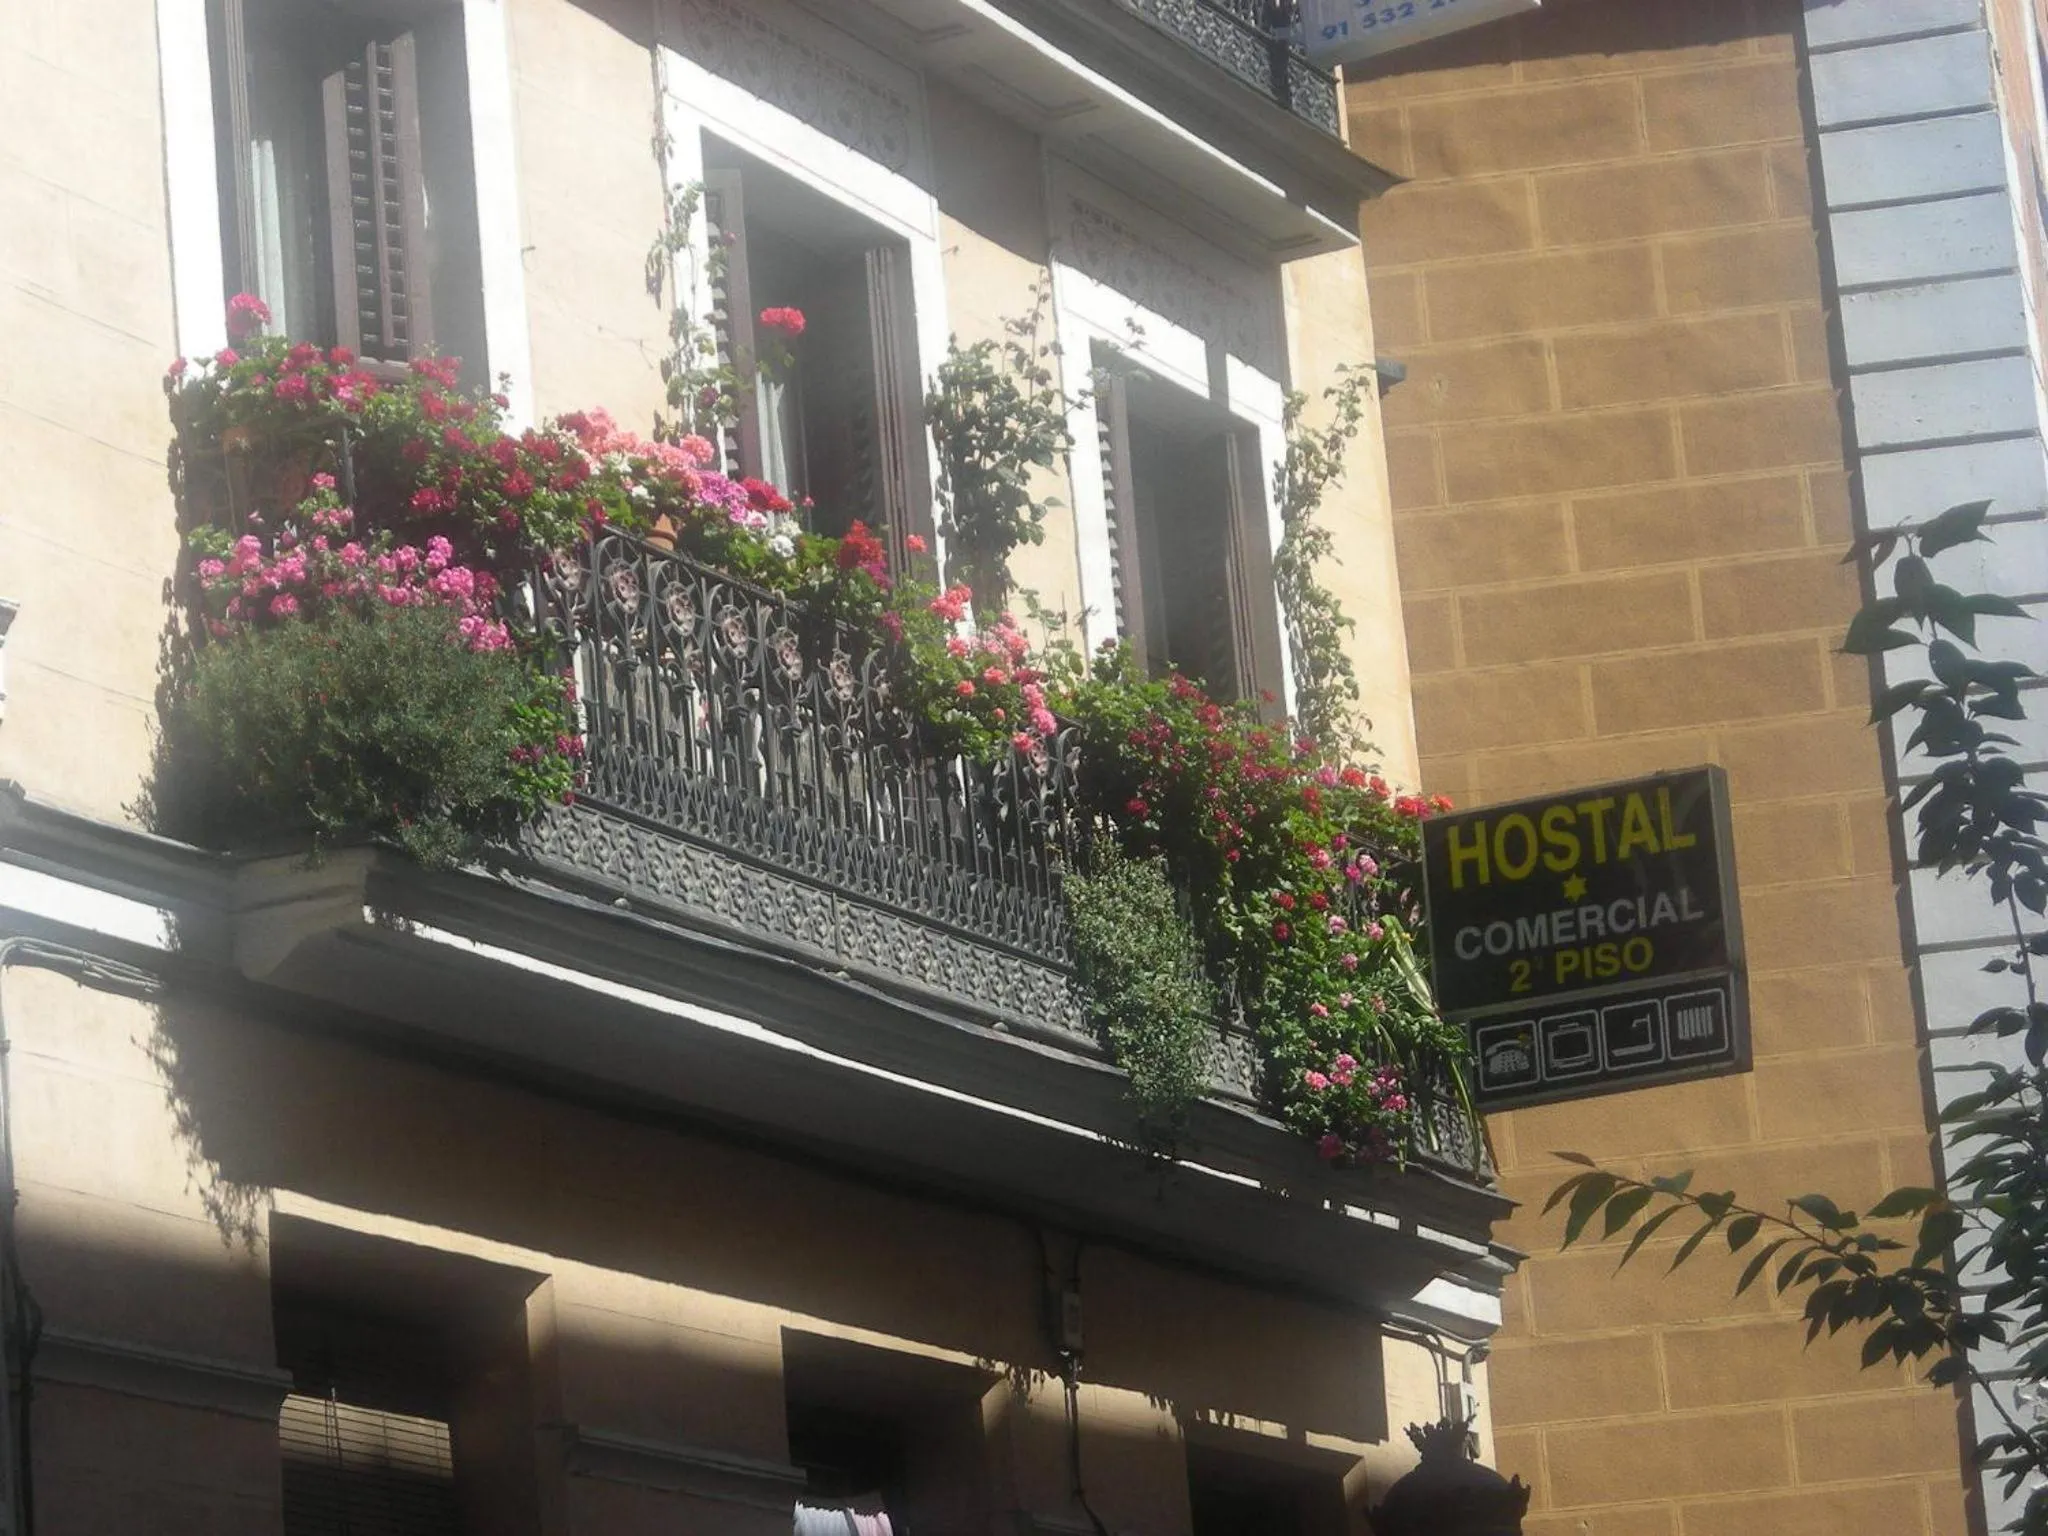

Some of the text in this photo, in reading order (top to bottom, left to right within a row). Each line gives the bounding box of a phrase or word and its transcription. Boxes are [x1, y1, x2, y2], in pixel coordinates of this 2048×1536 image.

[1321, 20, 1349, 40] 91
[1362, 2, 1415, 29] 532
[1447, 787, 1697, 890] HOSTAL
[1454, 886, 1704, 961] COMERCIAL
[1555, 936, 1654, 985] PISO
